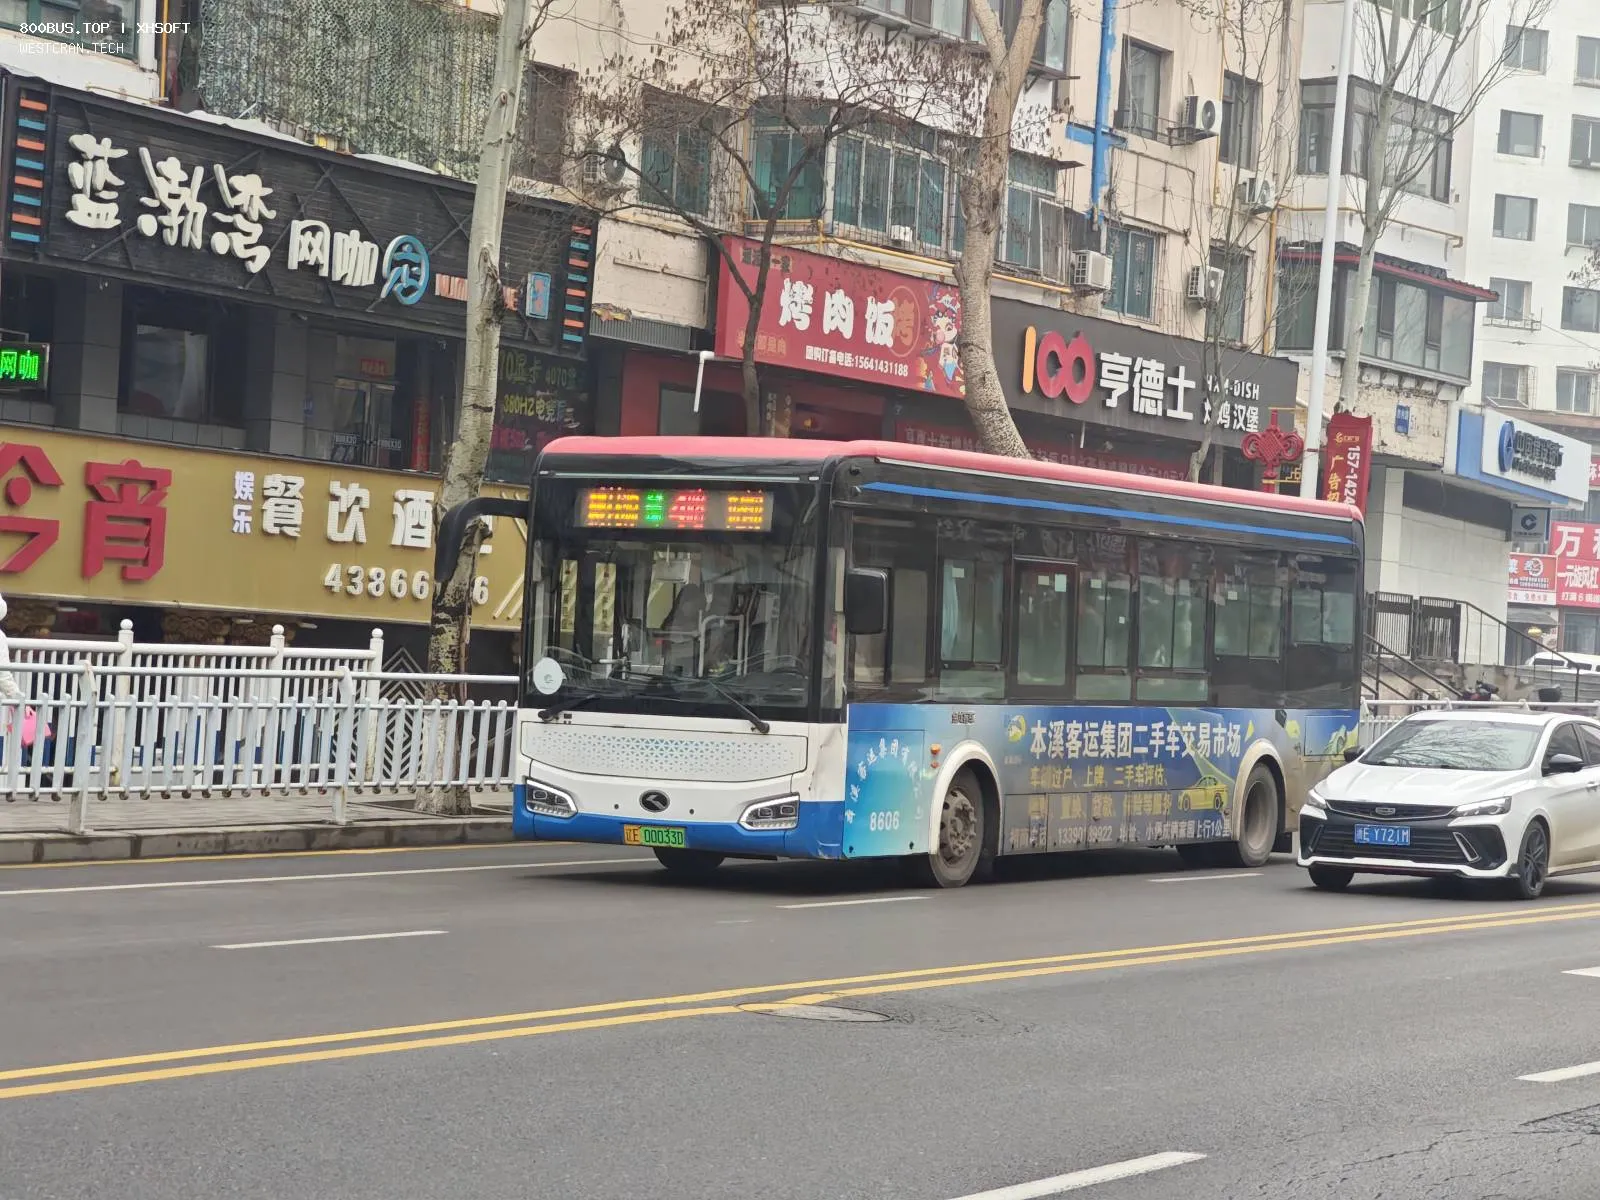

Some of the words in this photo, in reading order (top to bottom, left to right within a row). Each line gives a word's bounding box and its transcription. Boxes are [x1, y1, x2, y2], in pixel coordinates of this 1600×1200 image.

[287, 219, 379, 287] 网咖
[778, 277, 896, 348] 烤肉饭
[0, 349, 39, 381] 网咖
[1100, 352, 1196, 421] 亨德士
[0, 441, 173, 581] 今宵
[232, 471, 255, 534] 娱乐
[1030, 719, 1241, 760] 本溪客运集团二手车交易市场
[869, 811, 901, 832] 8606
